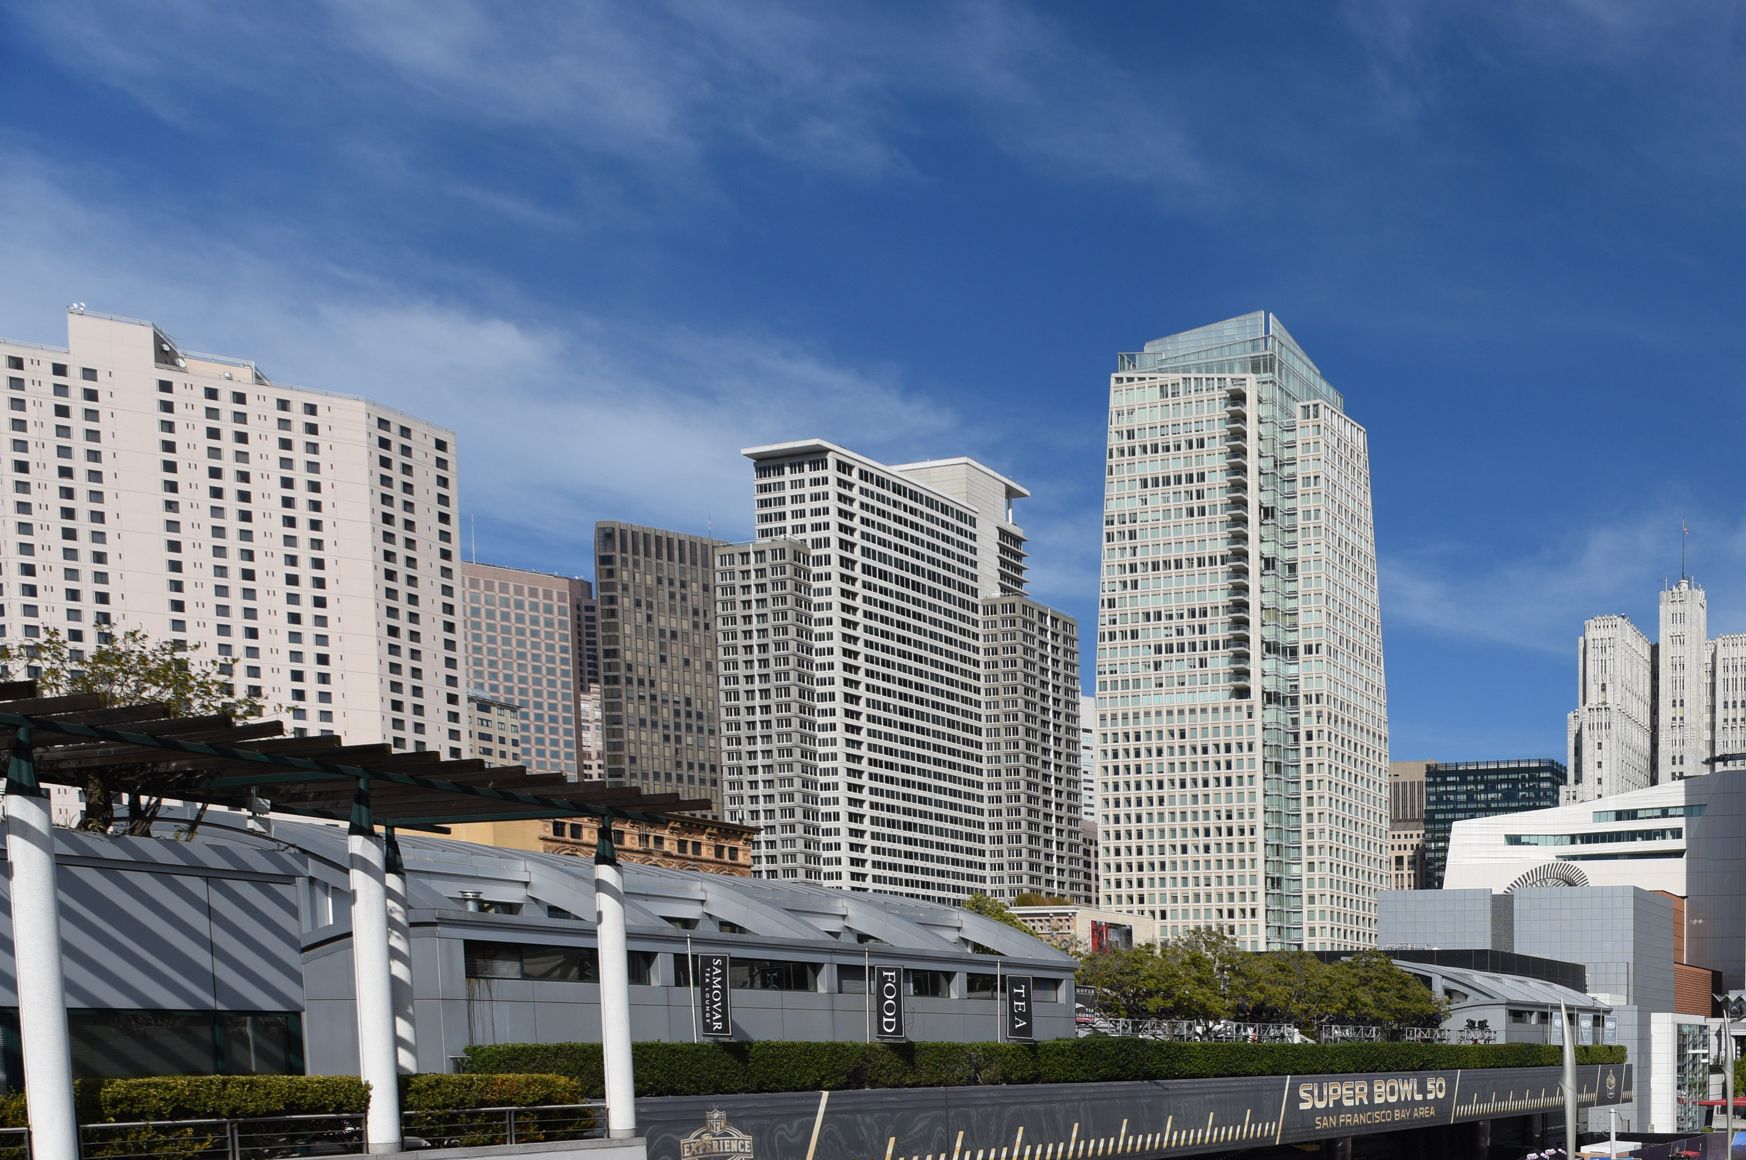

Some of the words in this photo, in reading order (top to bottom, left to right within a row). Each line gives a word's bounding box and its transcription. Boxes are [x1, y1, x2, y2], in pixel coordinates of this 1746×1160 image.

[712, 958, 723, 1031] SAMOVAR
[882, 970, 897, 1033] FOOD
[1013, 985, 1027, 1028] TEA
[1299, 1080, 1369, 1110] SUPER
[1373, 1077, 1423, 1104] BOWL
[1426, 1076, 1446, 1100] 50
[1315, 1116, 1337, 1130] SAN
[1339, 1109, 1392, 1126] FRANCISCO
[1394, 1108, 1410, 1121] BAY
[1412, 1106, 1436, 1119] AREA
[684, 1138, 751, 1157] EXPERIENCE
